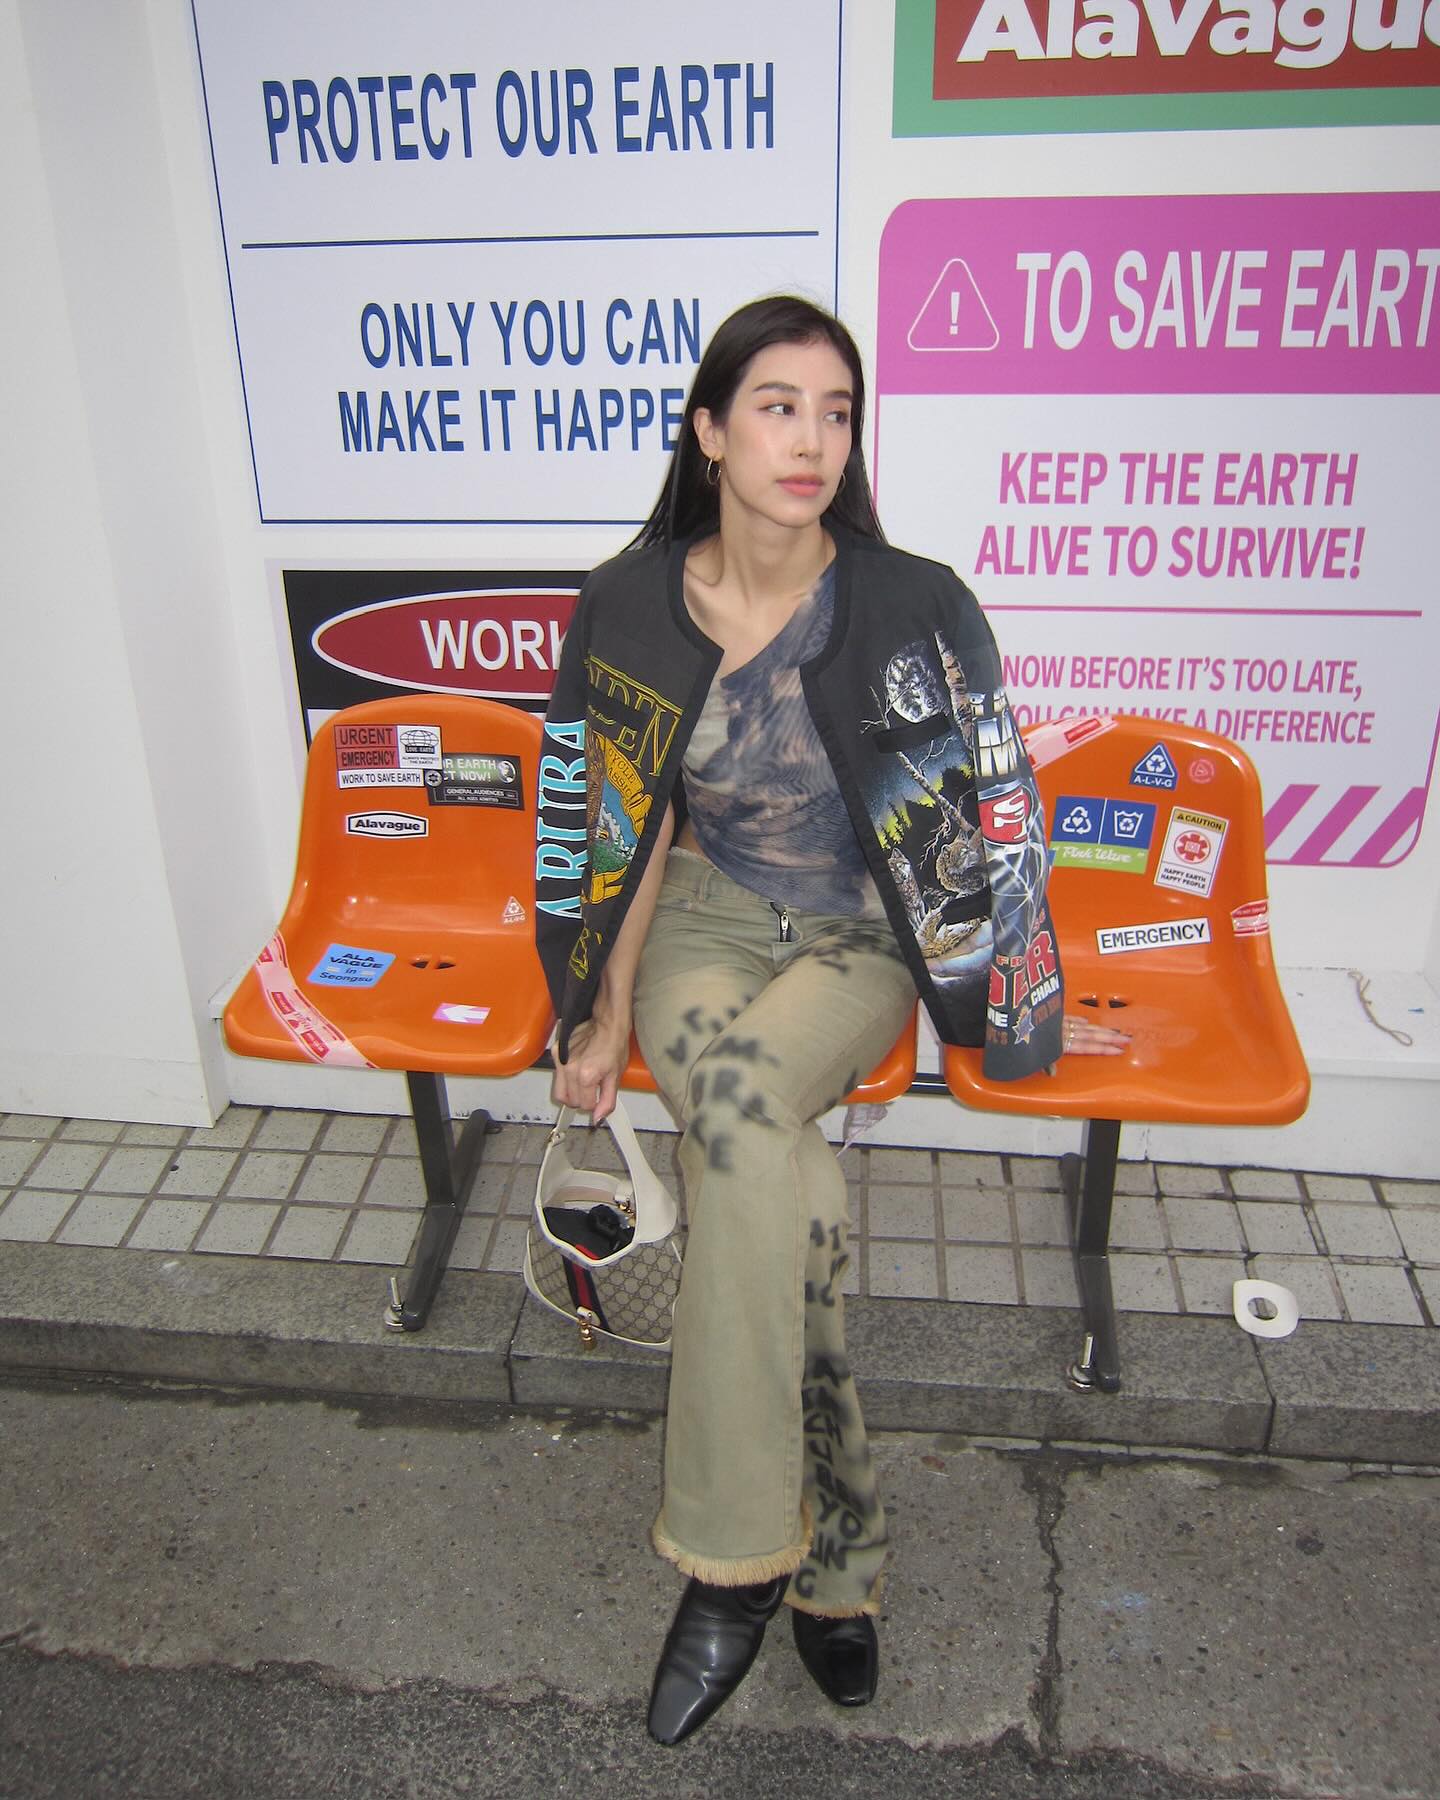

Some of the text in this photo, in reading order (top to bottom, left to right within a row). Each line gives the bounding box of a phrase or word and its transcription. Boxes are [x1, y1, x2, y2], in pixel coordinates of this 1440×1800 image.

[262, 62, 775, 165] PROTECT OUR EARTH
[1015, 249, 1093, 350] TO
[1109, 249, 1268, 351] SAVE
[360, 298, 701, 369] ONLY YOU CAN
[337, 389, 464, 453] MAKE
[479, 389, 516, 452] IT
[1000, 452, 1359, 507] KEEP THE EARTH
[973, 525, 1366, 580] ALIVE TO SURVIVE!
[1001, 655, 1362, 702] NOW BEFORE IT’S TOO LATE,
[1215, 708, 1376, 744] DIFFERENCE
[339, 727, 393, 746] URGENT
[341, 751, 396, 767] EMERGENCY
[457, 759, 497, 770] EARTH
[342, 772, 421, 785] WORK TO SAVE EARTH
[461, 771, 492, 782] NOW!
[1133, 776, 1173, 789] A-L-V-G
[354, 818, 421, 833] Alavague
[1184, 814, 1223, 831] CAUTION
[1160, 873, 1206, 889] HAPPY PEOPLE
[1163, 867, 1207, 882] HAPPY EARTH
[1101, 923, 1206, 950] EMERGENCY
[329, 956, 385, 969] VAGUE
[342, 952, 376, 963] ALA
[319, 971, 374, 984] Seongsu
[345, 967, 358, 975] in
